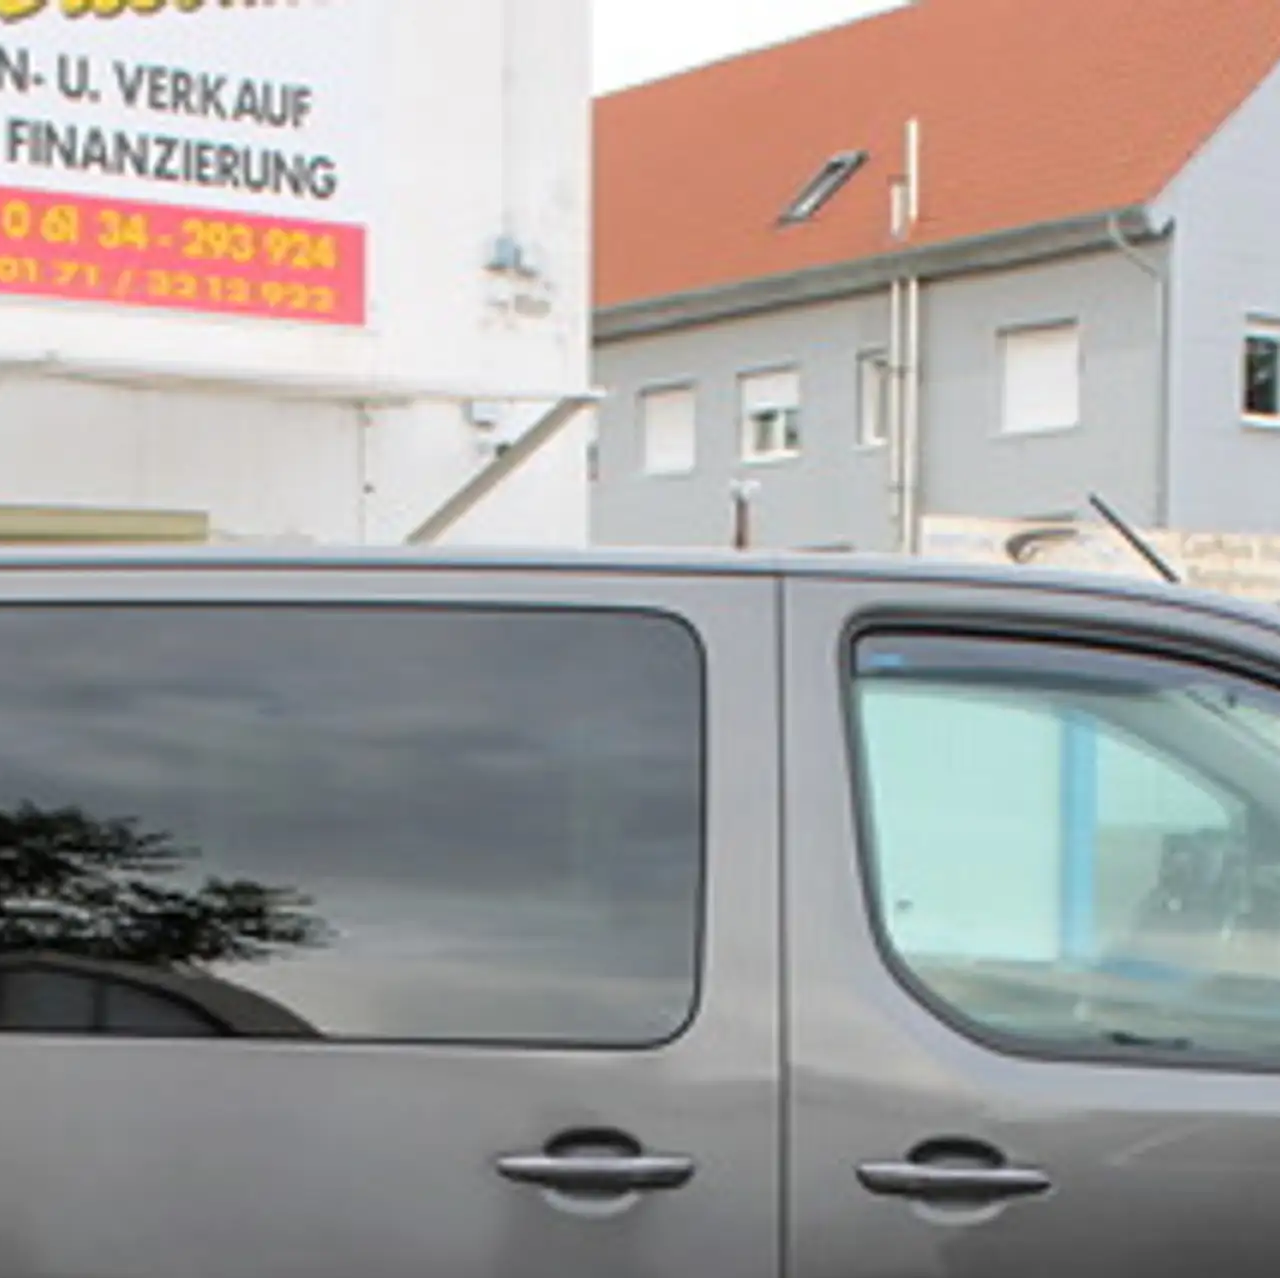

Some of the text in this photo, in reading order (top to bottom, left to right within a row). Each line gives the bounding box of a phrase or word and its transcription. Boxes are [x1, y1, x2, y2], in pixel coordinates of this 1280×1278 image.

[55, 53, 101, 102] U.
[111, 58, 313, 127] VERKAUF
[7, 116, 335, 198] FINANZIERUNG
[98, 209, 149, 250] 34
[182, 217, 255, 263] 293
